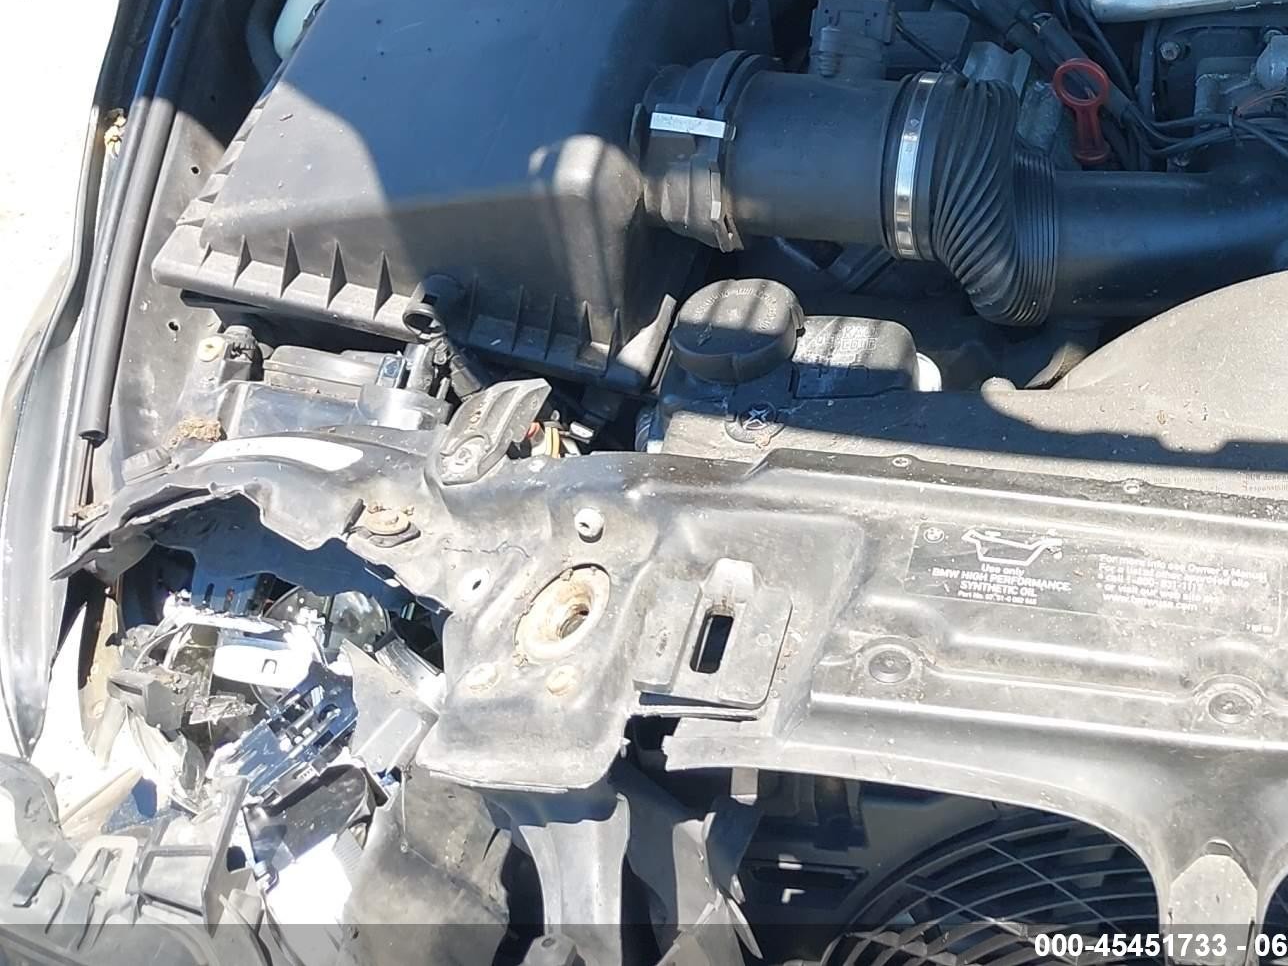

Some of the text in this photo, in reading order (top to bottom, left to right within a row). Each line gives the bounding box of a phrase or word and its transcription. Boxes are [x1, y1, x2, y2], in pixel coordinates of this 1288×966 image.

[981, 563, 1025, 578] Use only
[932, 567, 1072, 591] BMW HIGH PERFORMANCE
[957, 590, 973, 598] Part
[960, 580, 1037, 598] SYNTHETIC OIL
